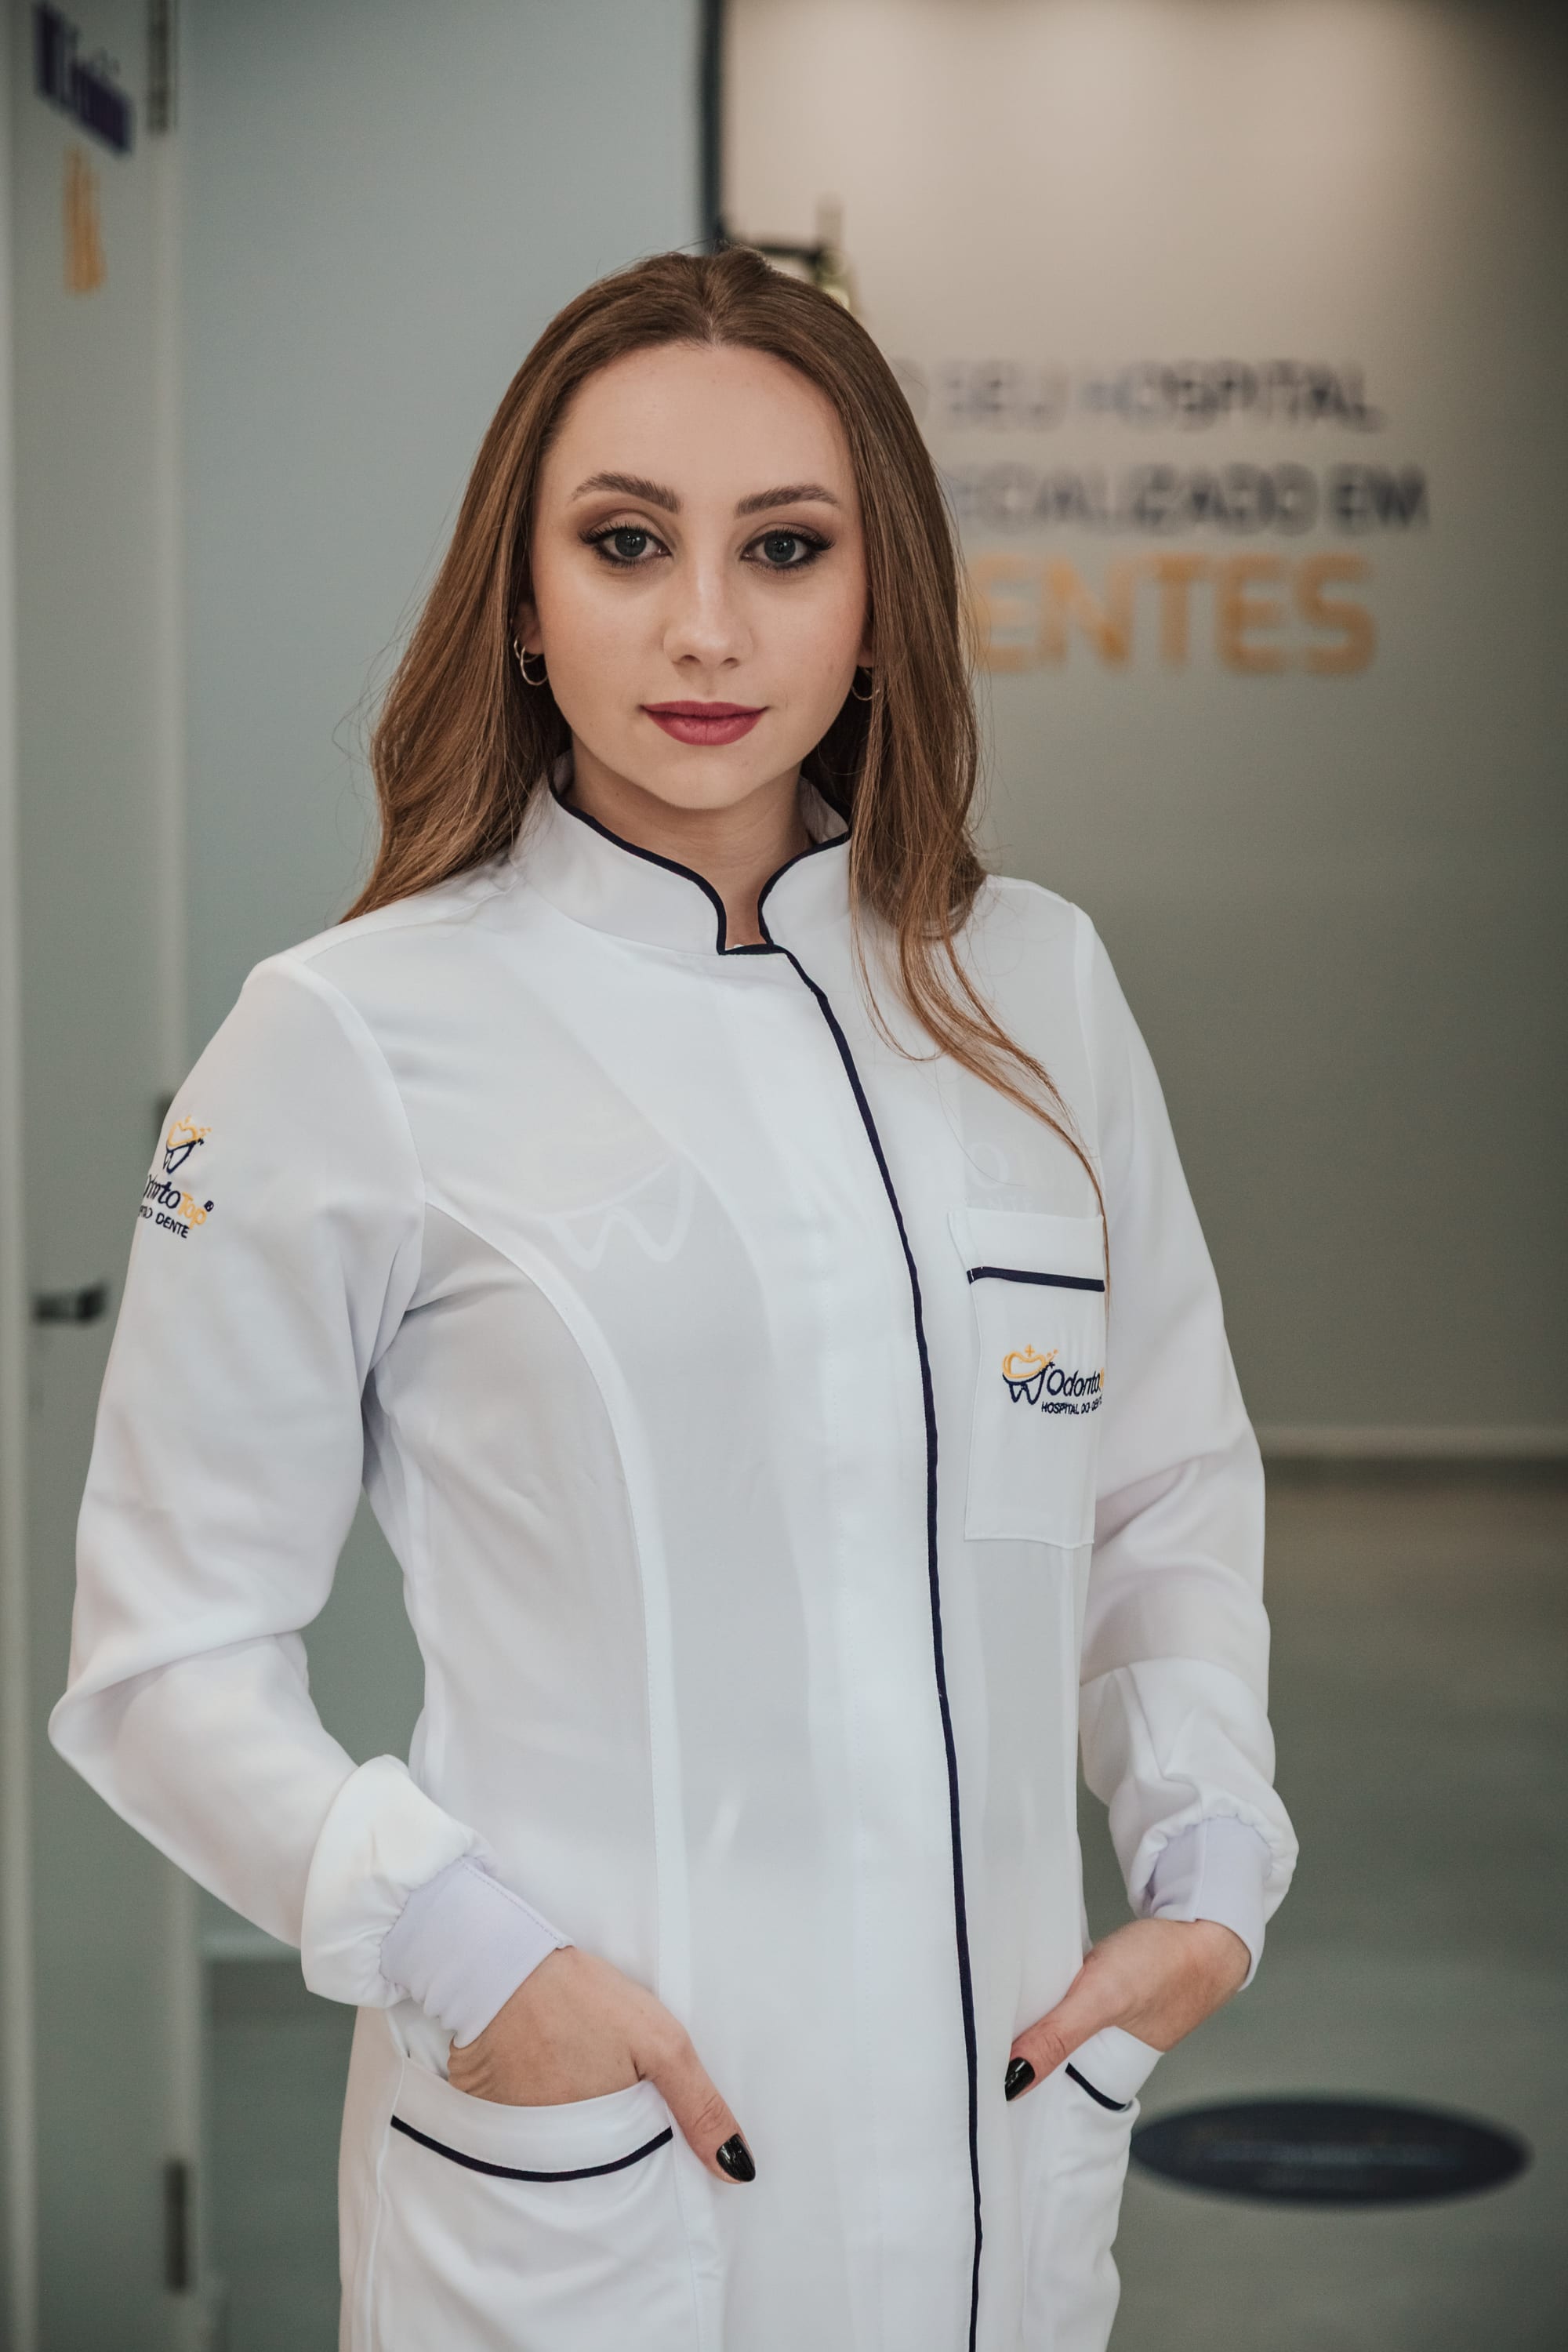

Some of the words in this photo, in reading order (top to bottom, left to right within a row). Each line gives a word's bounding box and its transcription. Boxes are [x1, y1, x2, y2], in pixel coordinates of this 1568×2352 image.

[1077, 358, 1386, 433] HOSPITAL
[1325, 461, 1431, 536] EM
[155, 1212, 189, 1238] DENTE
[1041, 1401, 1080, 1414] HOSPITAL
